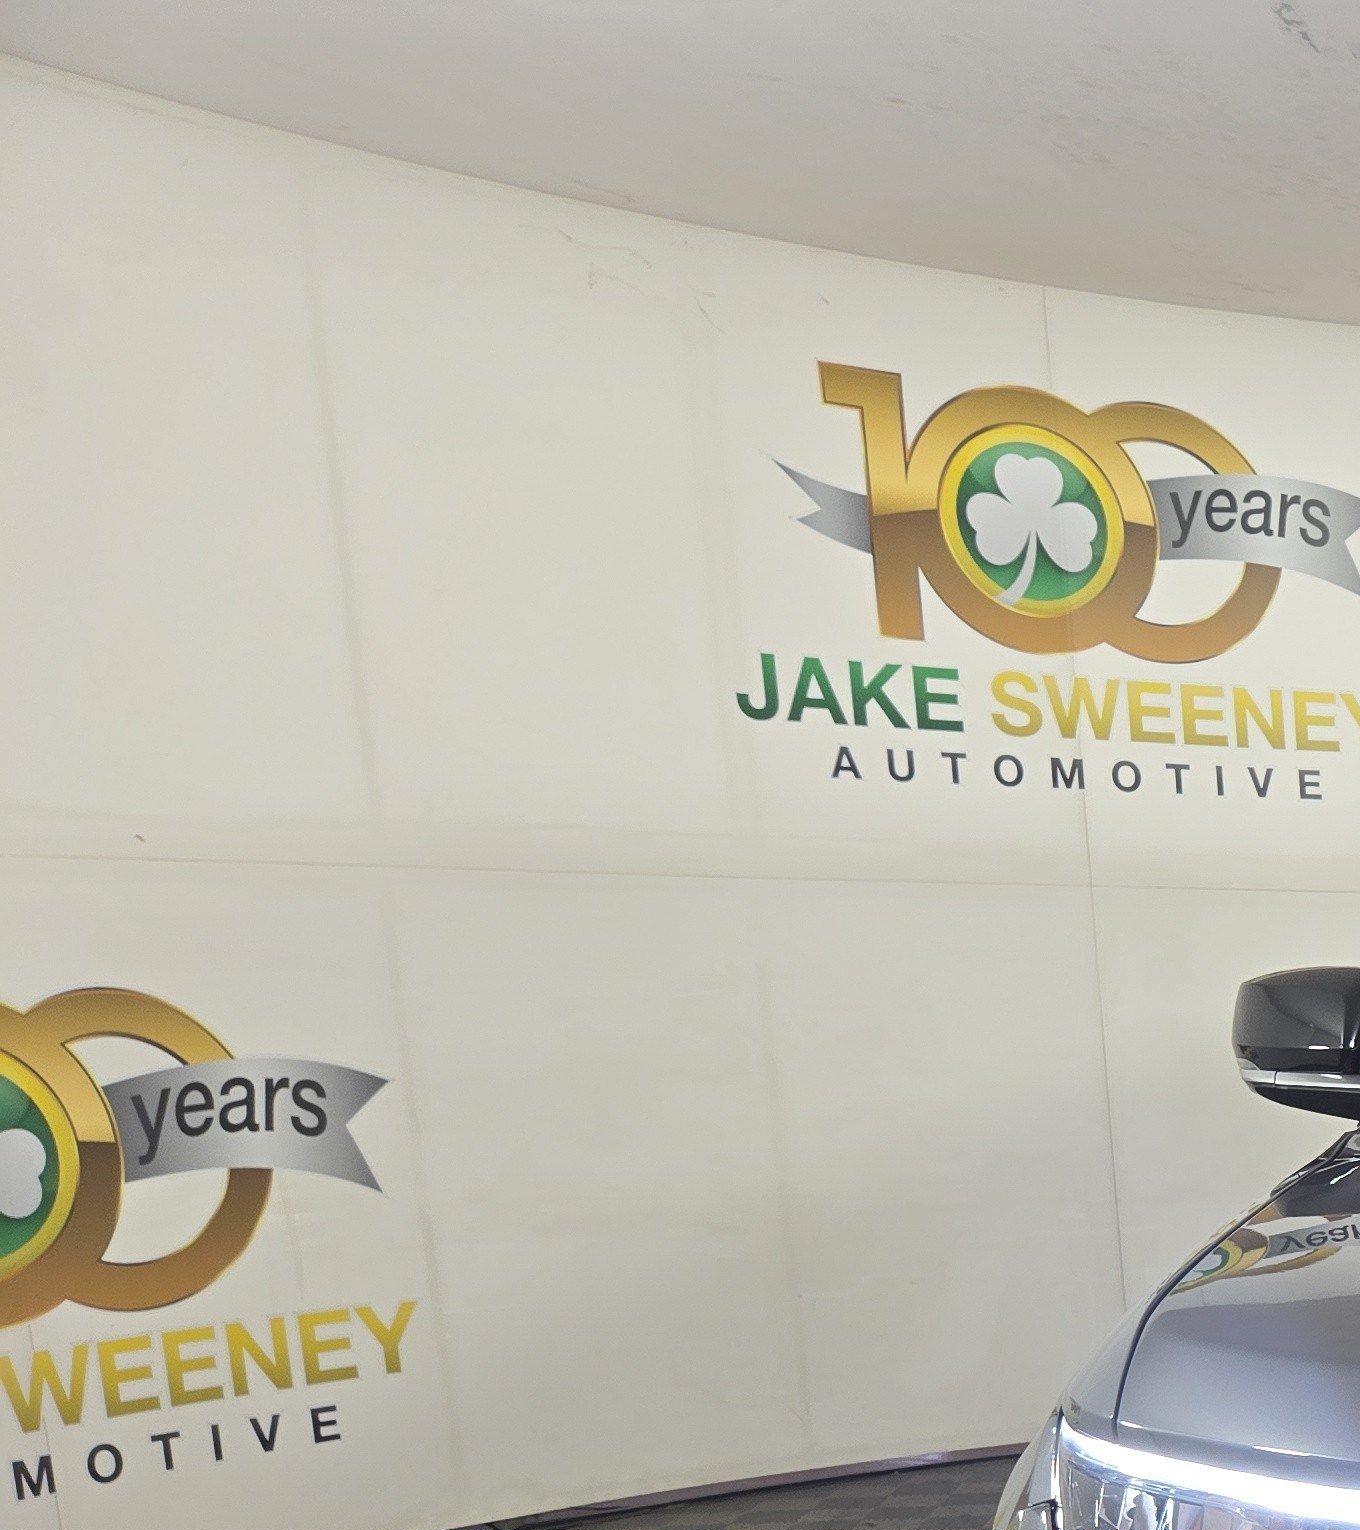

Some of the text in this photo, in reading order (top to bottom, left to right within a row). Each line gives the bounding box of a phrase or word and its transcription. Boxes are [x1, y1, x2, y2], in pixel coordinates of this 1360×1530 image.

[1169, 484, 1332, 549] years
[735, 653, 965, 733] JAKE
[831, 746, 1324, 801] AUTOMOTIVE
[130, 1075, 329, 1166] years
[12, 1405, 342, 1501] MOTIVE
